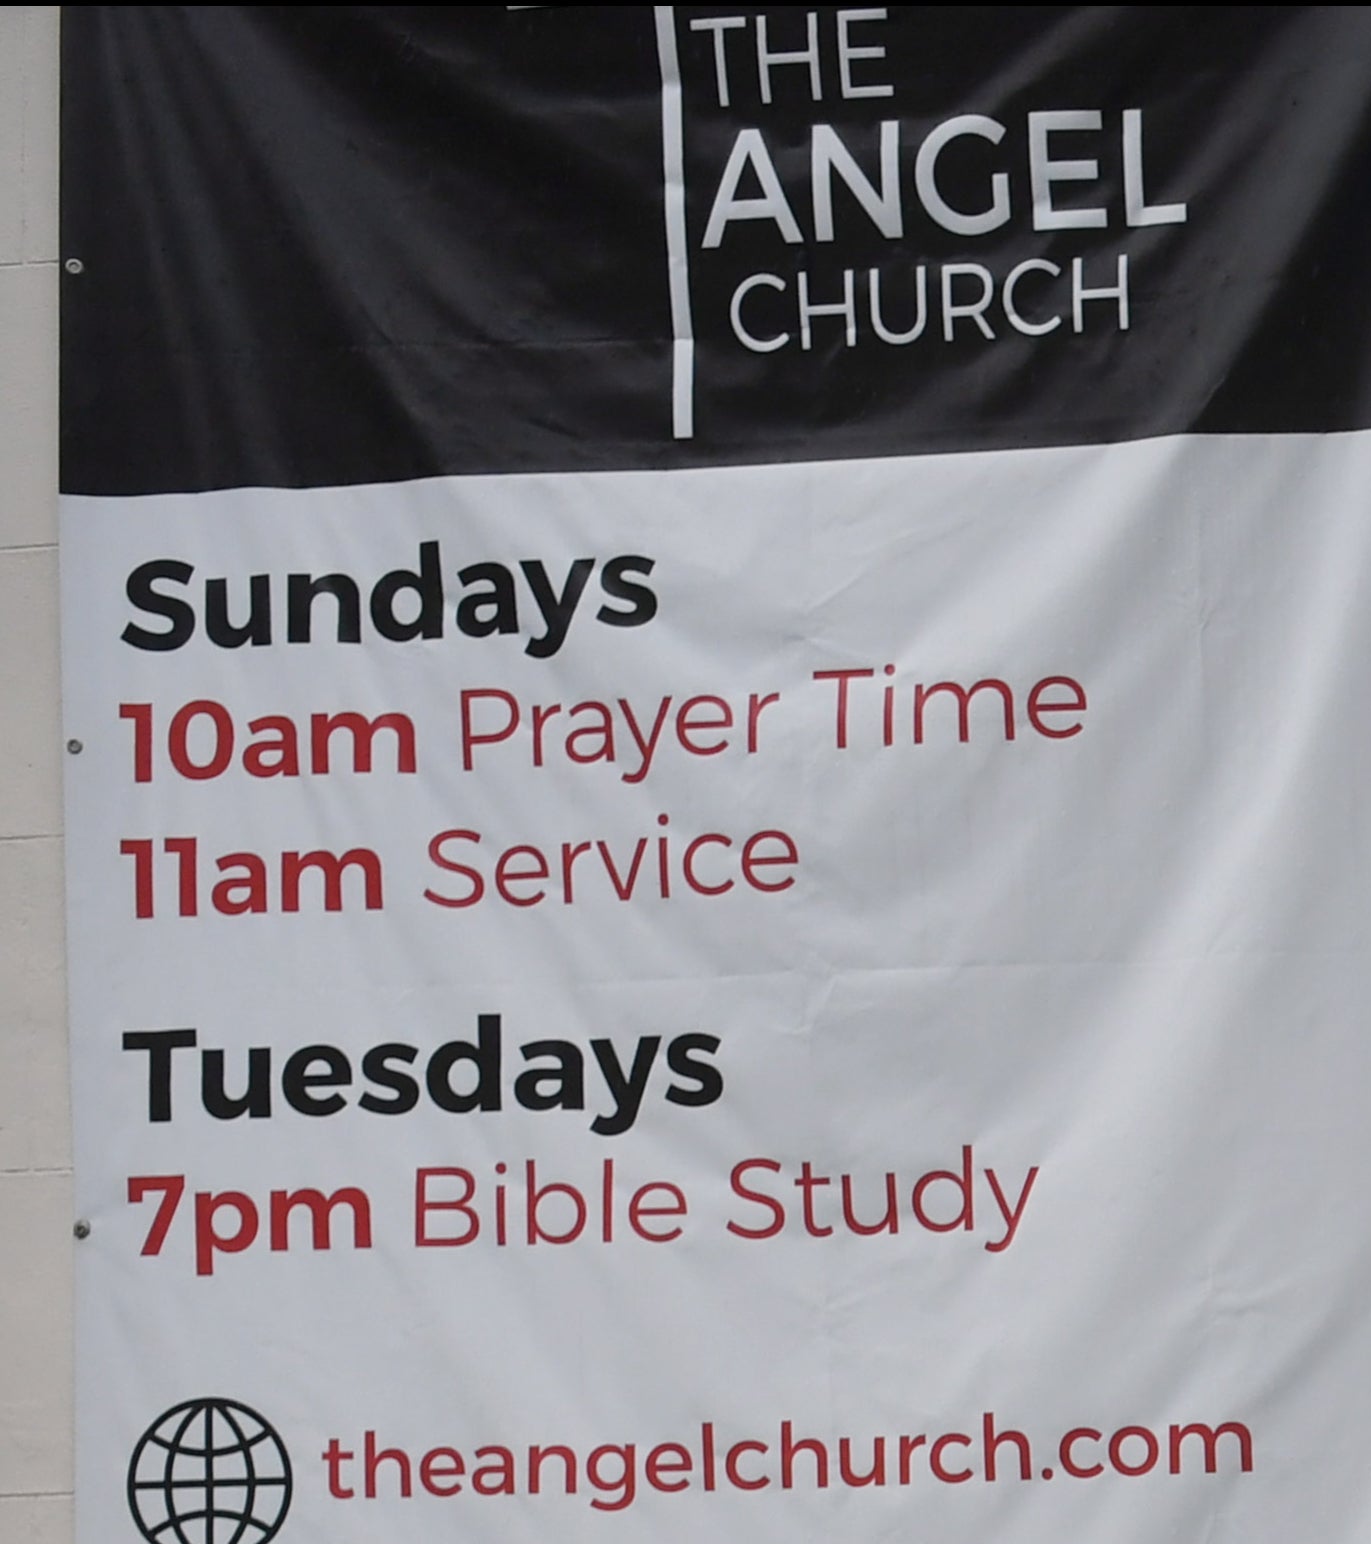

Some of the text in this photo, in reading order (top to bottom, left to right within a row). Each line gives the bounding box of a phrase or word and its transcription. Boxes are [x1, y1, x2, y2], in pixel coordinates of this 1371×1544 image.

[691, 8, 894, 107] THE
[702, 109, 1187, 249] ANGEL
[730, 254, 1130, 353] CHURCH
[120, 541, 658, 658] Sundays
[120, 666, 1087, 783] 10am Prayer Time
[120, 815, 799, 919] 11am Service
[122, 1014, 724, 1136] Tuesdays
[128, 1146, 1039, 1275] 7pm Bible Study
[323, 1413, 1254, 1511] theangelchurch.com
